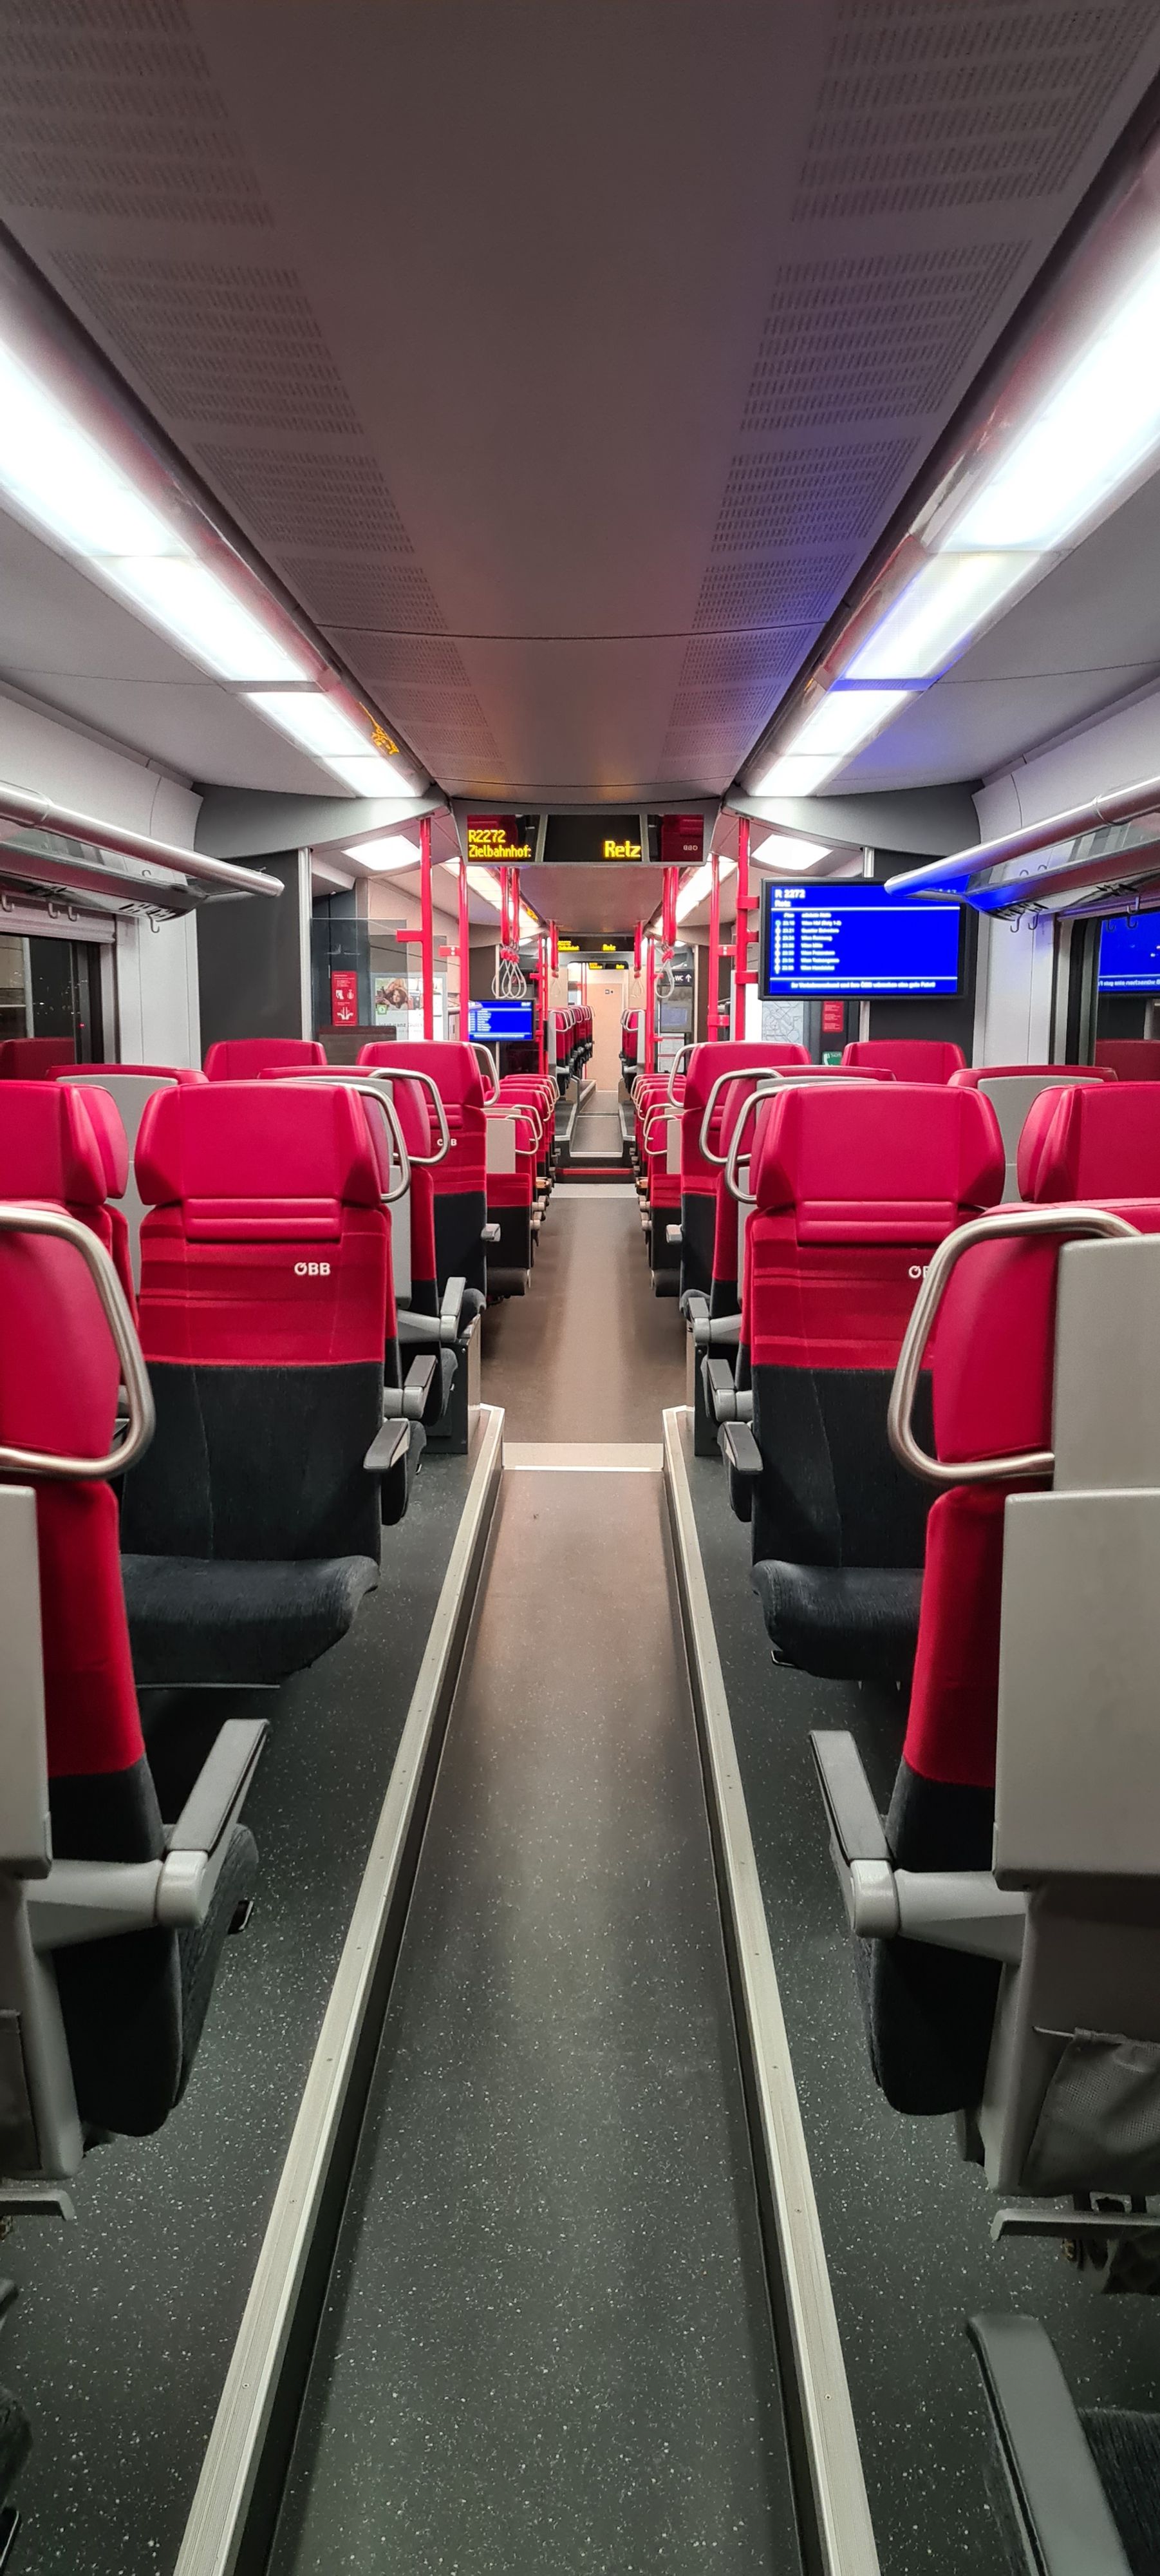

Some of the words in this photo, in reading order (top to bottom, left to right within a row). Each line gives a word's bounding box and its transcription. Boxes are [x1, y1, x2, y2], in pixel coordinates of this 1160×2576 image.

[469, 829, 506, 843] R2272
[469, 844, 532, 857] Zielbahnhof:
[605, 840, 641, 857] Retz
[775, 889, 782, 898] R
[784, 889, 805, 899] 2272
